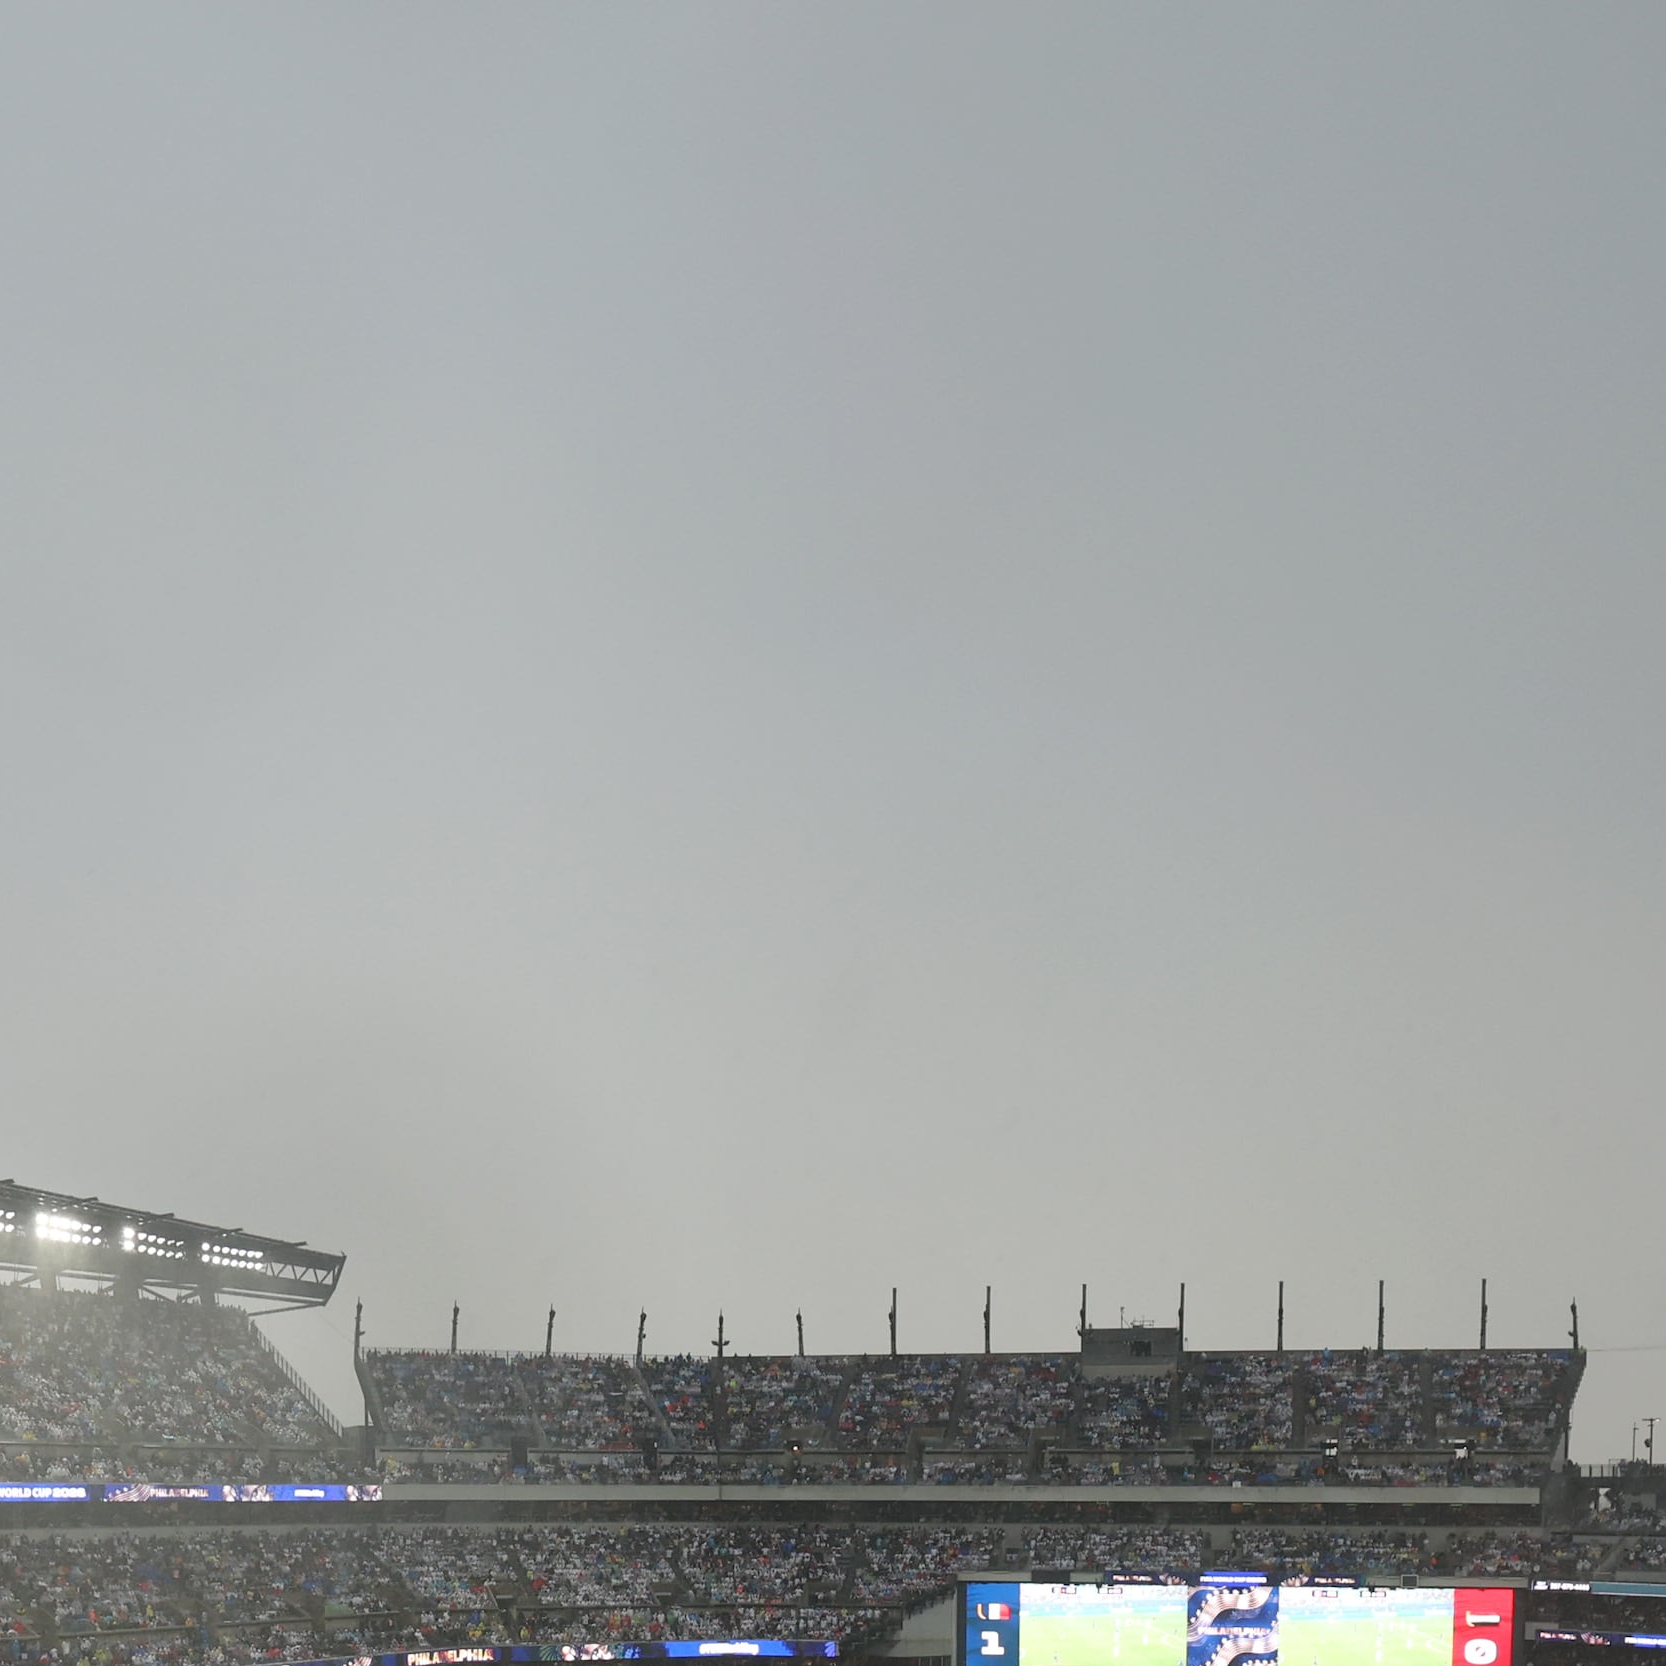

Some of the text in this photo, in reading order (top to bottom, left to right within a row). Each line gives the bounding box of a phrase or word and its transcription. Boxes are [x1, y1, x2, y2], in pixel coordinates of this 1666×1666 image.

[33, 1487, 51, 1498] CUP
[52, 1487, 87, 1498] 2026
[981, 1631, 1005, 1656] 1
[1464, 1638, 1498, 1665] 0
[407, 1648, 494, 1666] PHILADELPHIA
